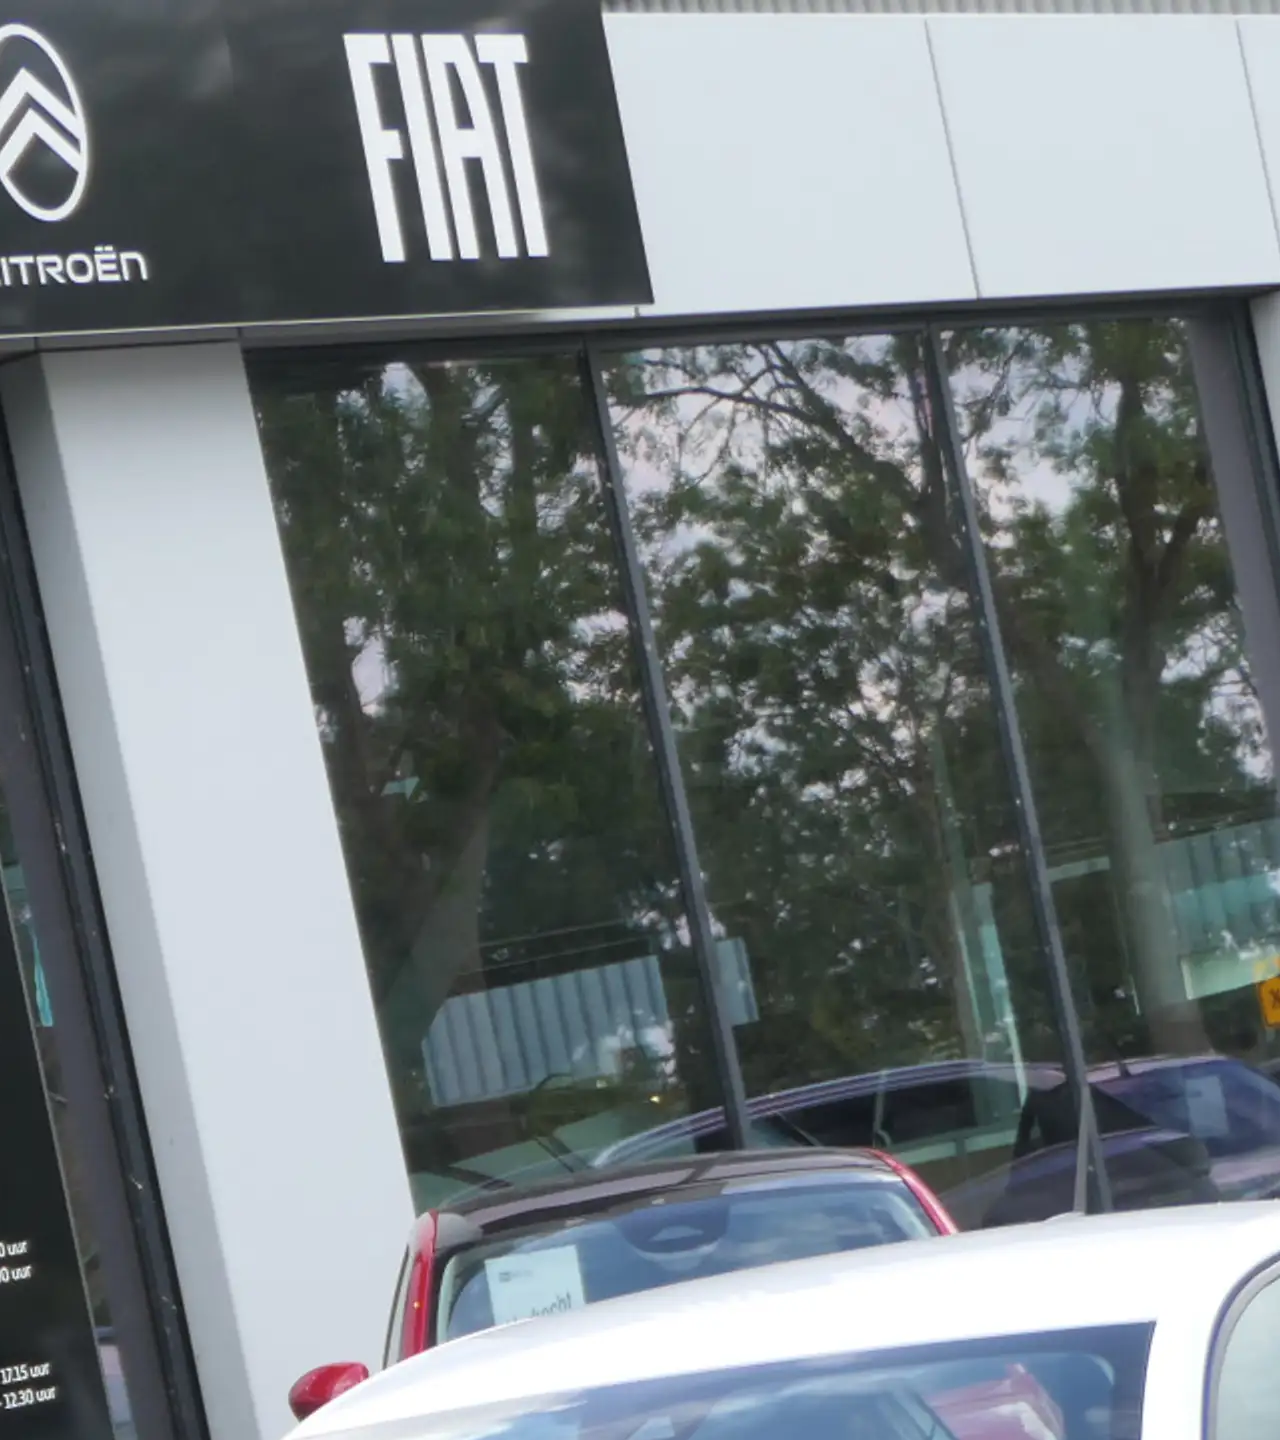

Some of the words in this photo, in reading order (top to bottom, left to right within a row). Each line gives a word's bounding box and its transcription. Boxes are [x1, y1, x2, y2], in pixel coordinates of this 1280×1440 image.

[343, 33, 549, 262] FIAT
[6, 1241, 28, 1256] uur
[11, 1265, 32, 1280] uur
[29, 1362, 50, 1378] uur
[35, 1386, 56, 1402] uur
